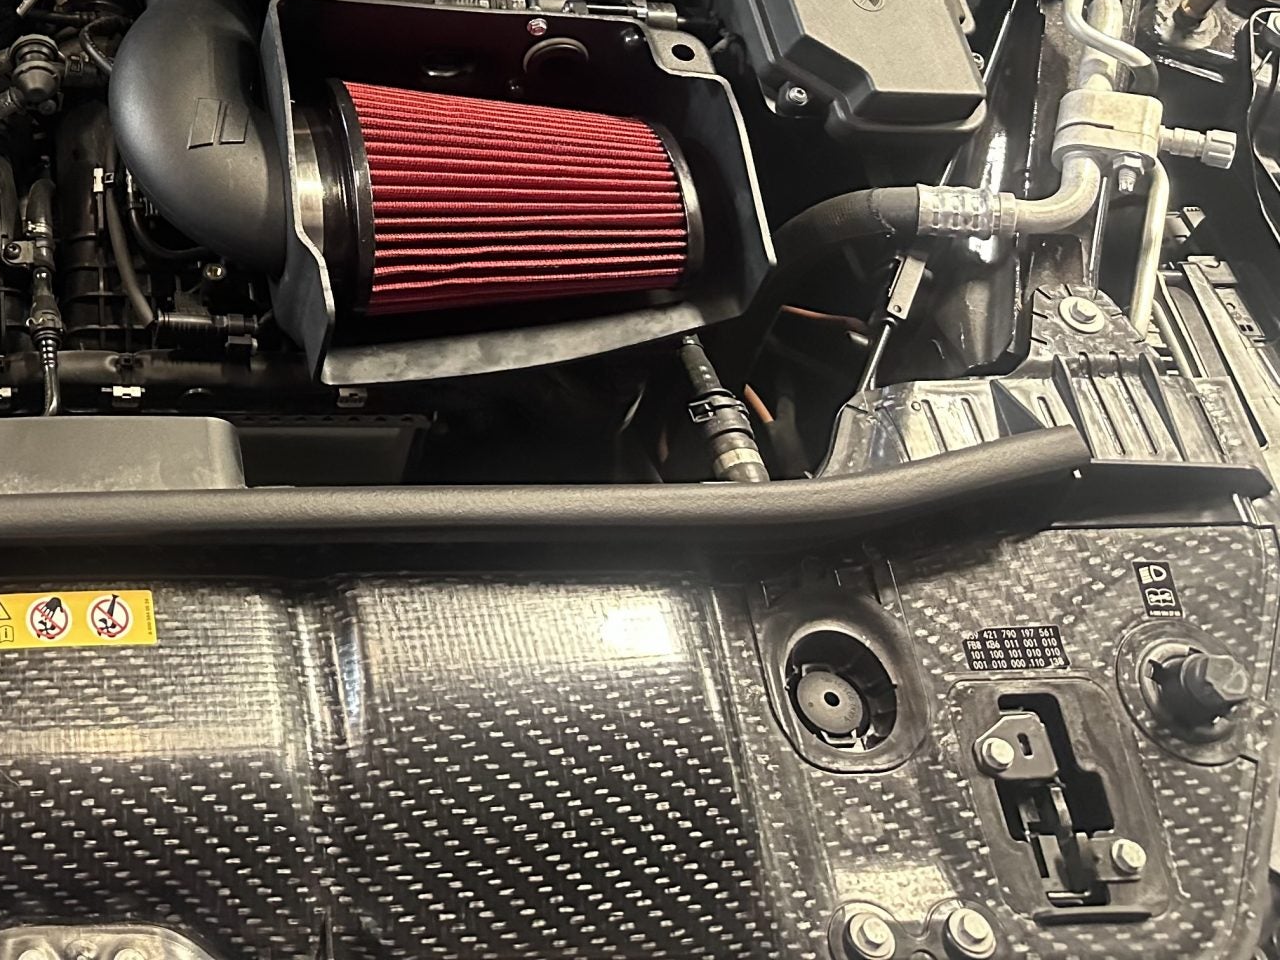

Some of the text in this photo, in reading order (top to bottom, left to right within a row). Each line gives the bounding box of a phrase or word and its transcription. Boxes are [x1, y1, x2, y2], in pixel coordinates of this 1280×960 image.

[983, 630, 998, 639] 421
[1001, 629, 1016, 638] 790
[1021, 629, 1034, 638] 197
[1039, 628, 1054, 637] 561
[1004, 639, 1019, 648] 011
[1023, 638, 1038, 647] 001
[1042, 638, 1057, 647] 010
[971, 647, 1060, 659] 101 100 101 010 010
[973, 660, 988, 669] 001
[992, 660, 1007, 668] 010
[1011, 659, 1026, 668] 000
